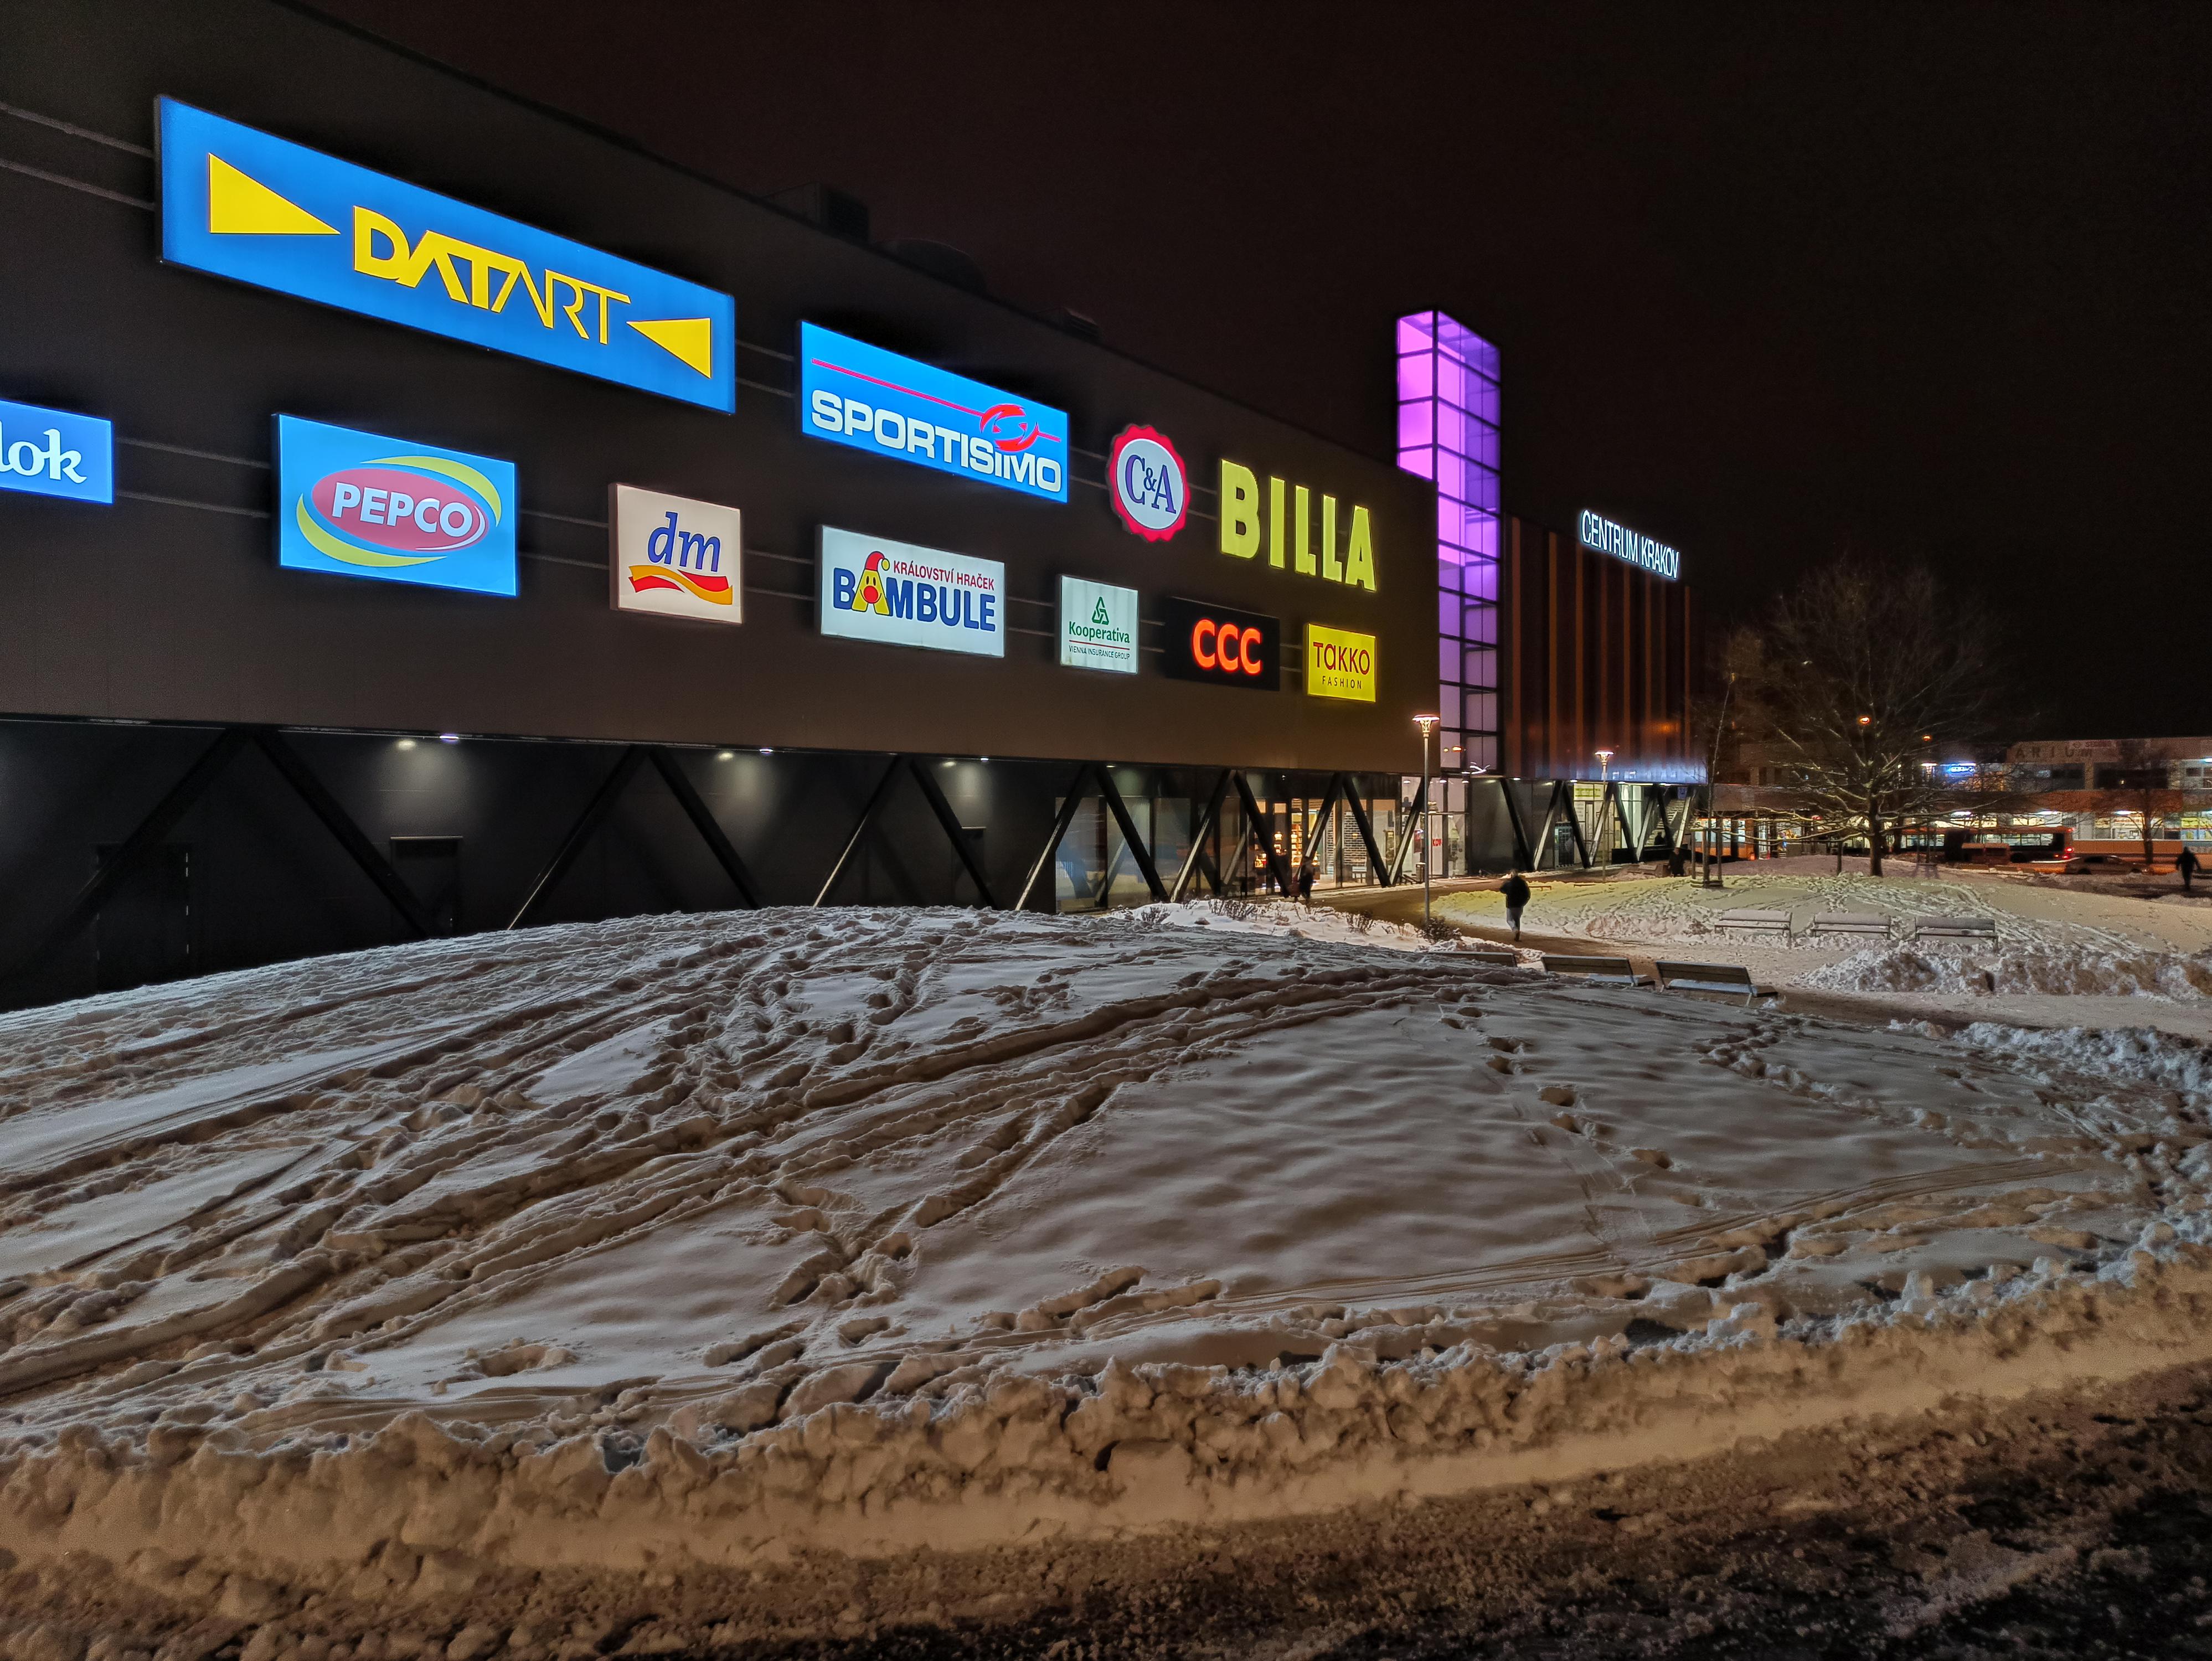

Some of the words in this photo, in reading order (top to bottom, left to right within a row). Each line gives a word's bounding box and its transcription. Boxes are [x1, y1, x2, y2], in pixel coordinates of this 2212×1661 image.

[353, 205, 631, 344] DATART
[811, 389, 1061, 492] SPORTISIMO
[332, 482, 473, 538] PEPCO
[1125, 454, 1177, 514] C&A
[647, 511, 721, 572] dm
[1220, 459, 1376, 592] BILLA
[1581, 509, 1638, 564] CENTRUM
[1641, 535, 1679, 579] KRAKOV
[833, 565, 996, 632] BAMBULE
[893, 560, 955, 584] KRÁLOVSTVÍ
[957, 573, 995, 591] HRAČEK
[1069, 621, 1130, 643] Kooperativa
[1069, 644, 1087, 654] VIENNA
[1087, 648, 1114, 658] INSURANCE
[1115, 651, 1130, 660] GROUP
[1192, 618, 1263, 675] CCC
[1322, 675, 1363, 690] FASHION
